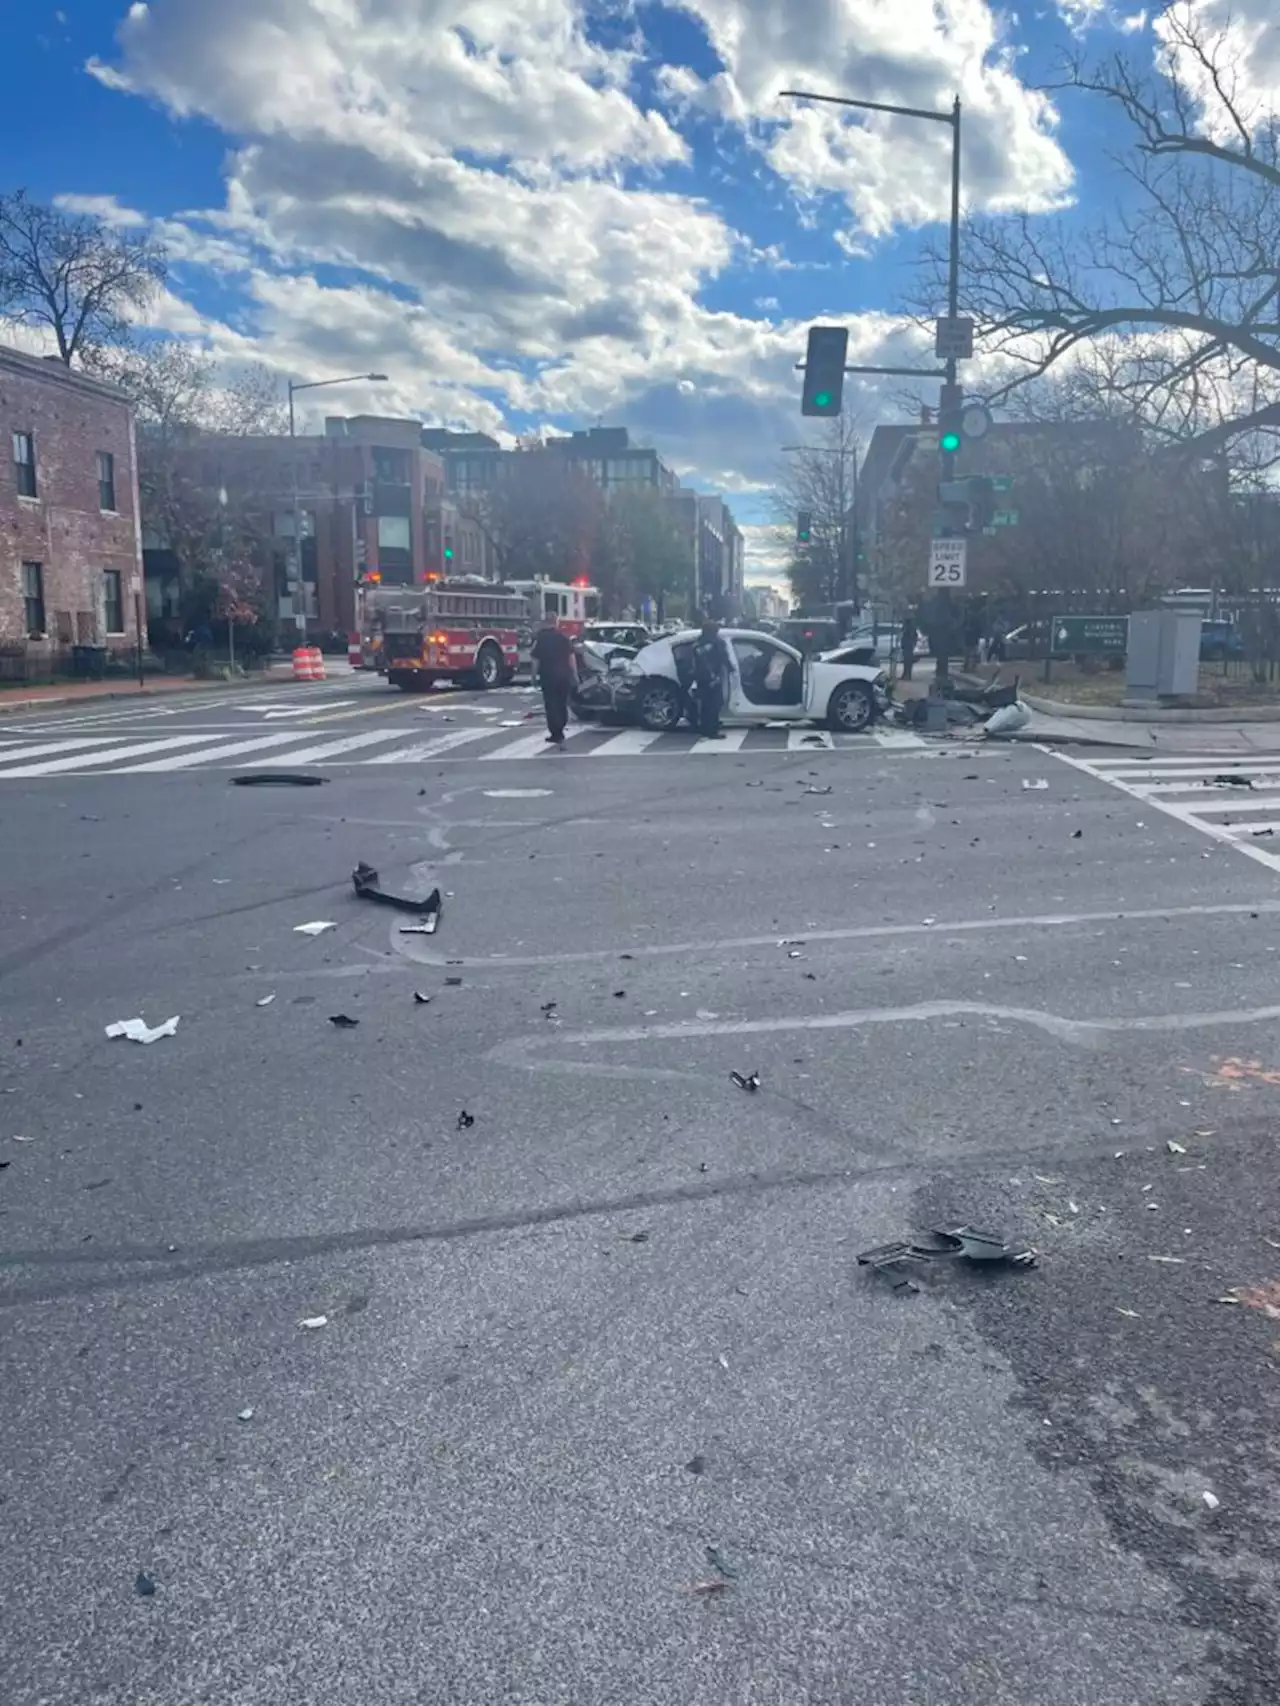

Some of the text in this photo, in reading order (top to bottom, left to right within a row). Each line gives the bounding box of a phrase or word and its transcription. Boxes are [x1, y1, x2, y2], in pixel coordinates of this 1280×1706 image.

[933, 543, 963, 551] SPEED
[935, 552, 960, 561] LIMIT
[934, 563, 961, 581] 25
